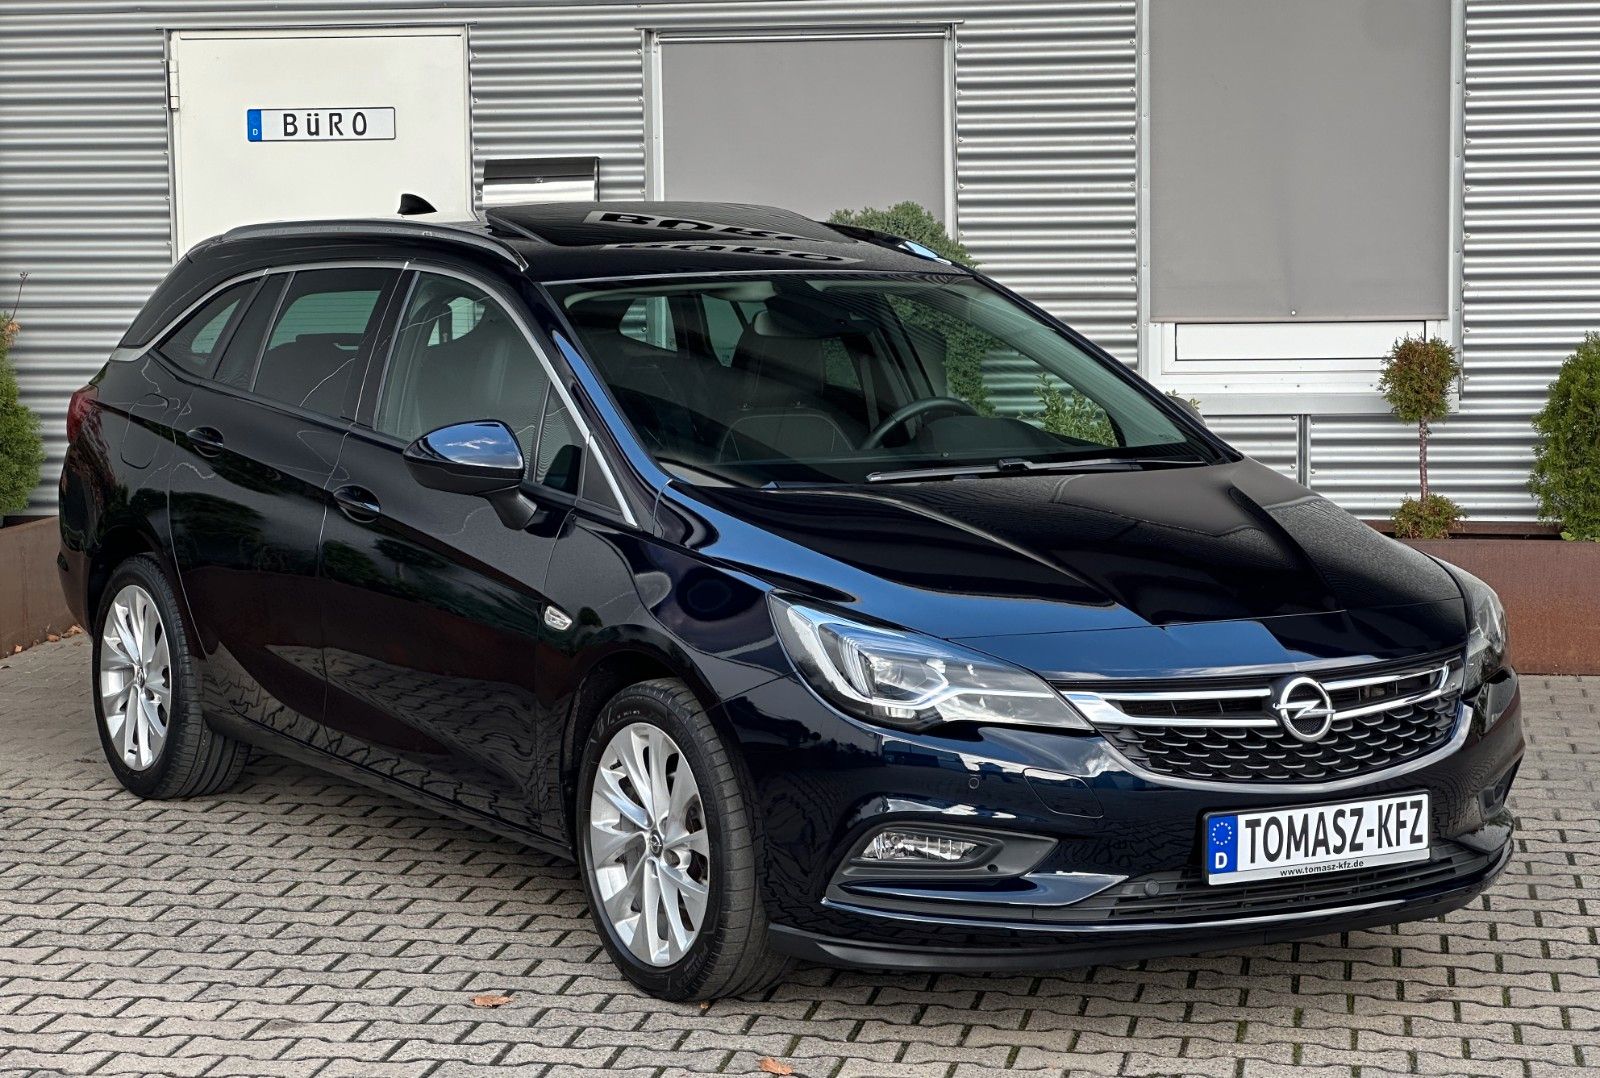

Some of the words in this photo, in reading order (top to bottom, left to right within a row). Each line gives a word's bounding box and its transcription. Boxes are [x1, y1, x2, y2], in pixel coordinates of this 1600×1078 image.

[252, 128, 259, 136] D
[1245, 799, 1424, 864] TOMASZ-KFZ
[1215, 852, 1228, 869] D
[1279, 859, 1364, 877] www.tomasz-kfz.de
